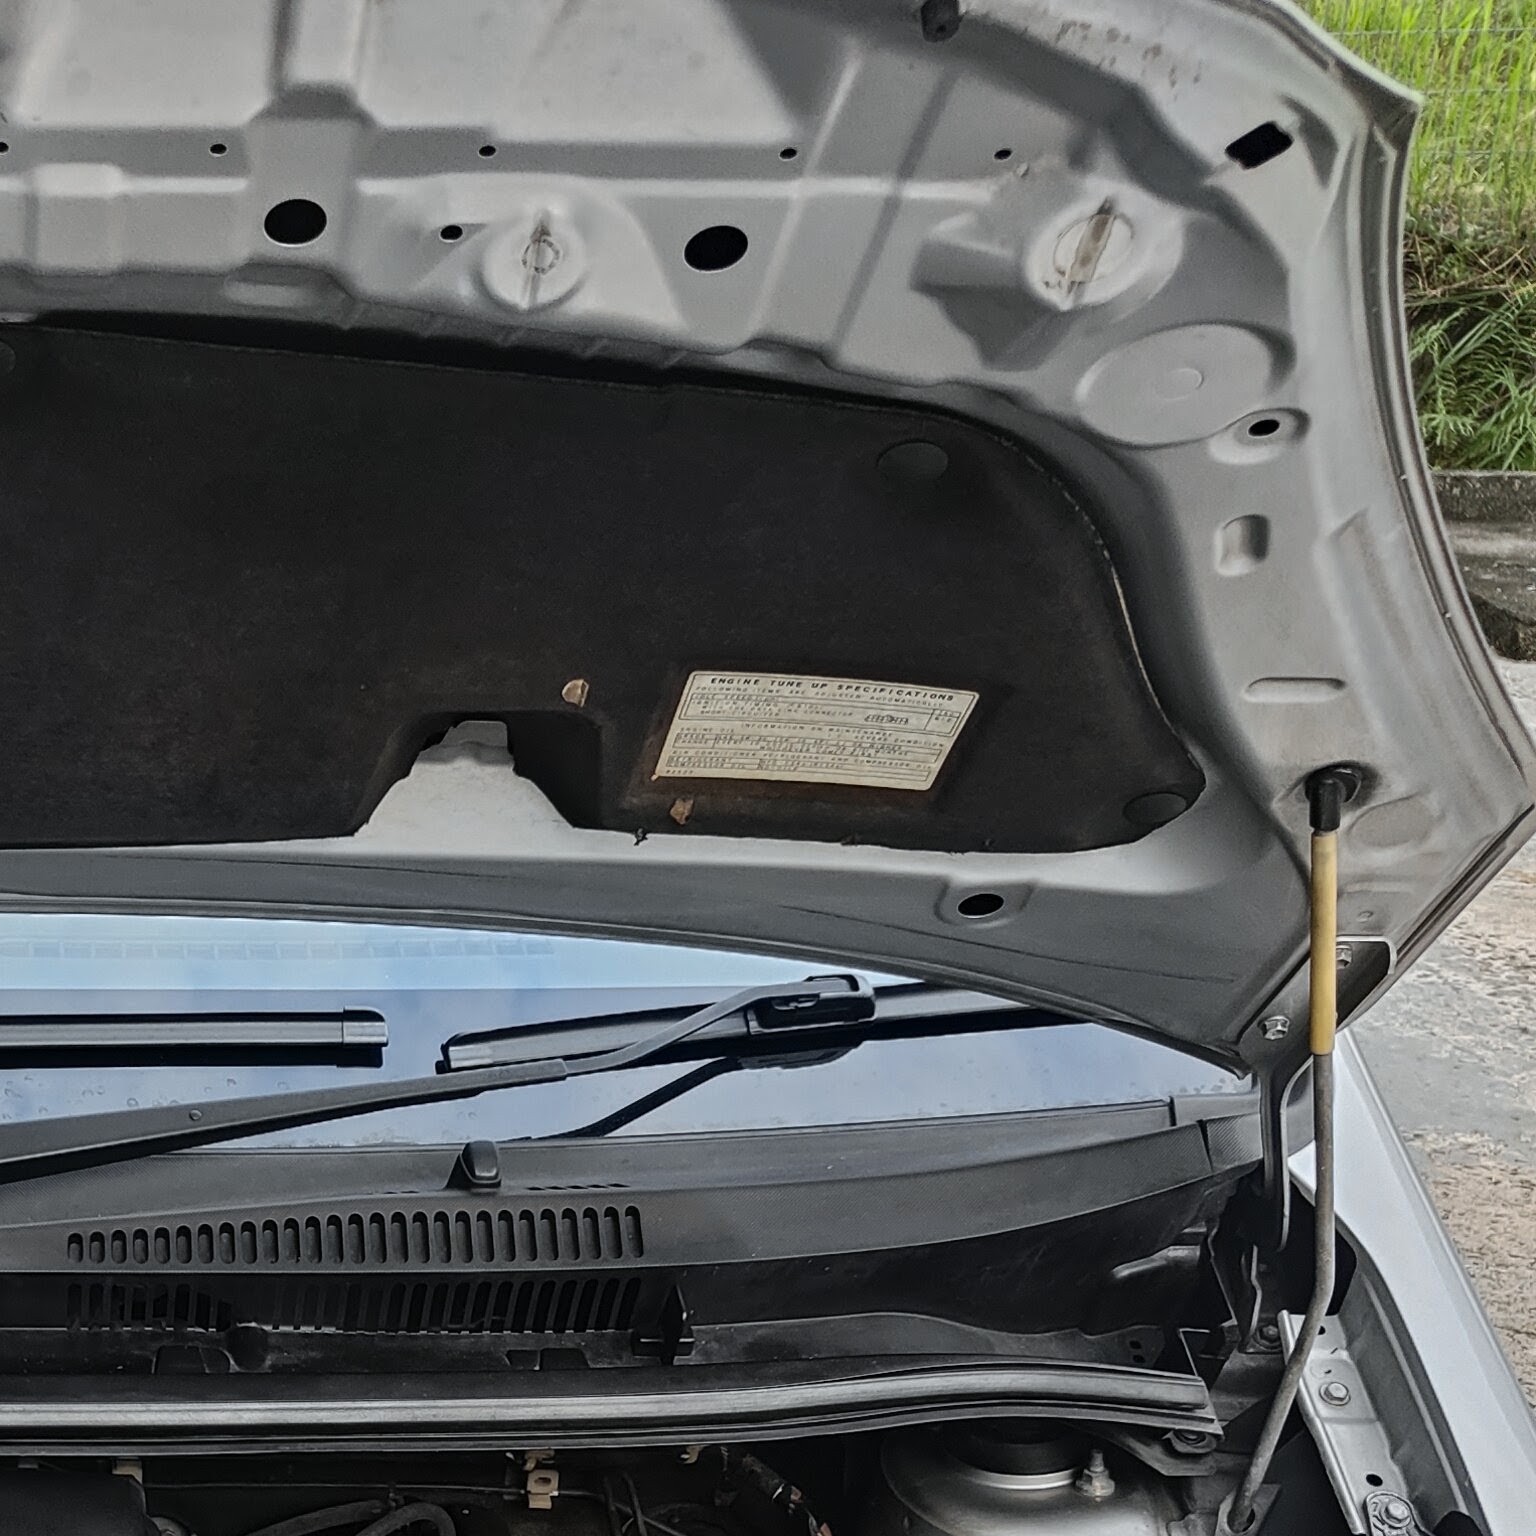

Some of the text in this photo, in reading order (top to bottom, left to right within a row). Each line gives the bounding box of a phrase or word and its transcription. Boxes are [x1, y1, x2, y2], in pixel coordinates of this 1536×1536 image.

[710, 677, 761, 686] ENGINE
[770, 680, 803, 688] TUNE
[837, 683, 955, 701] SPECIFICATIONS
